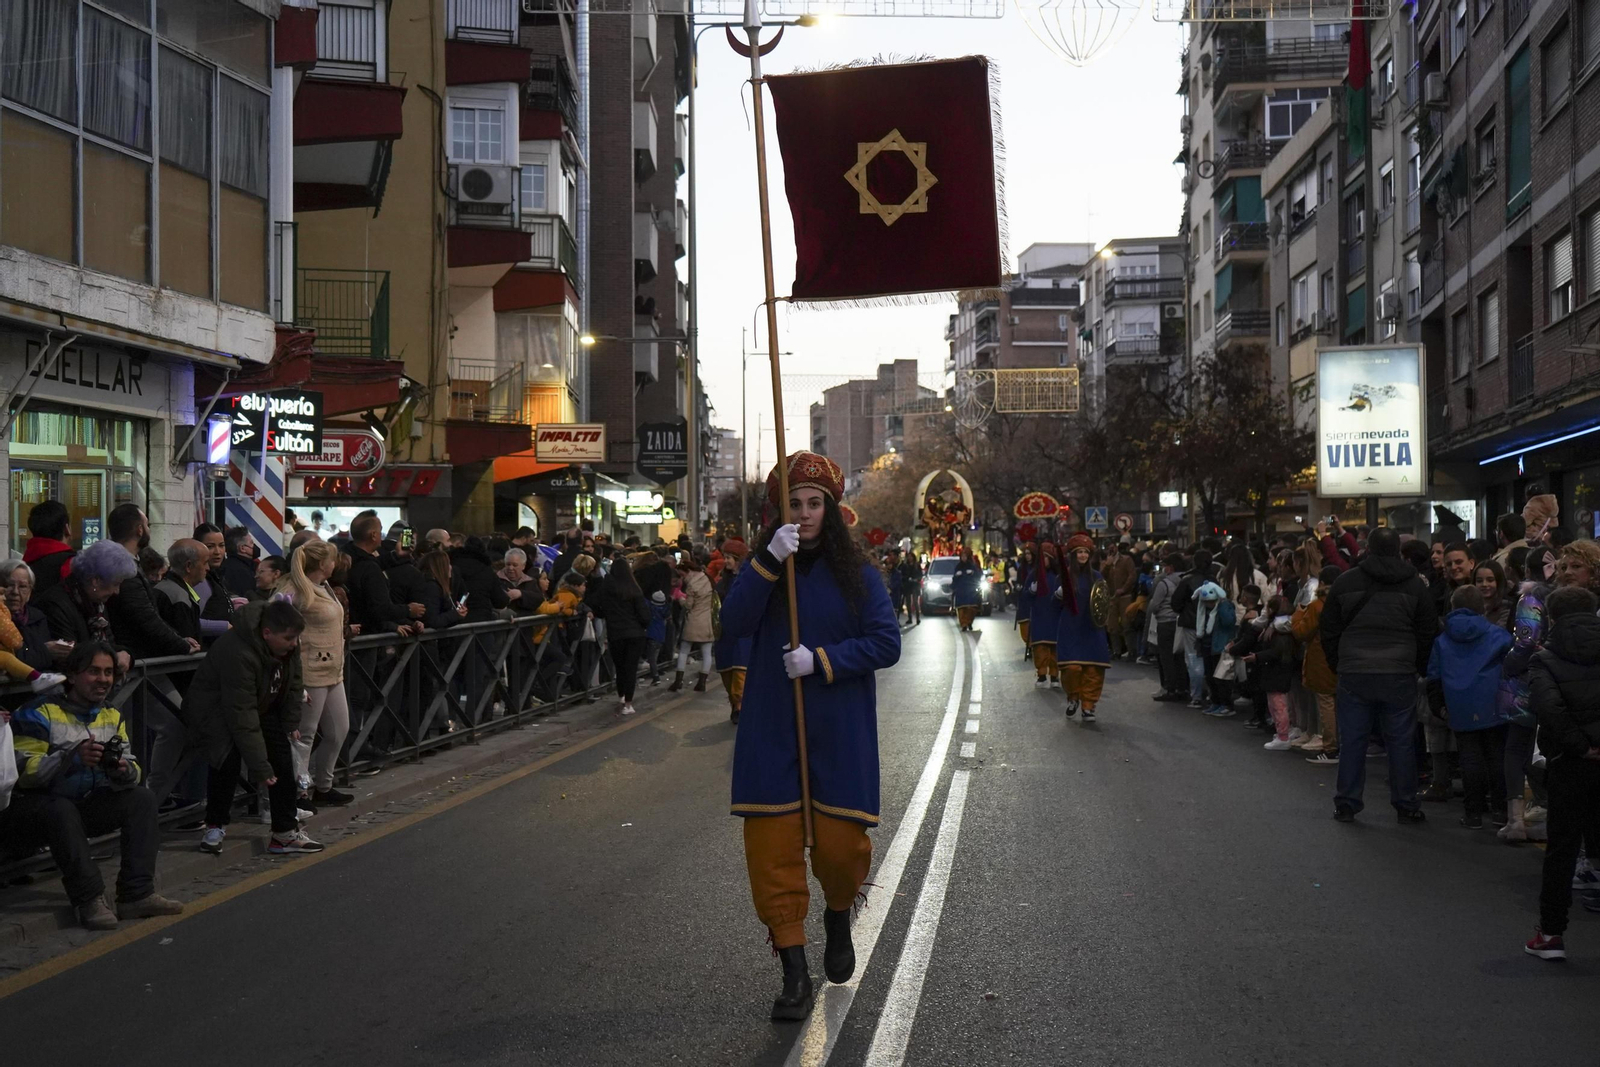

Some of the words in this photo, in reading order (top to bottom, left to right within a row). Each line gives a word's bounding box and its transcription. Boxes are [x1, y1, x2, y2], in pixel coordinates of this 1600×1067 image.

[266, 430, 314, 453] Sultán
[538, 431, 602, 443] IMPACTO
[647, 431, 682, 450] ZAIDA
[1325, 428, 1410, 441] sierranevada
[1326, 441, 1412, 468] VÍVELA
